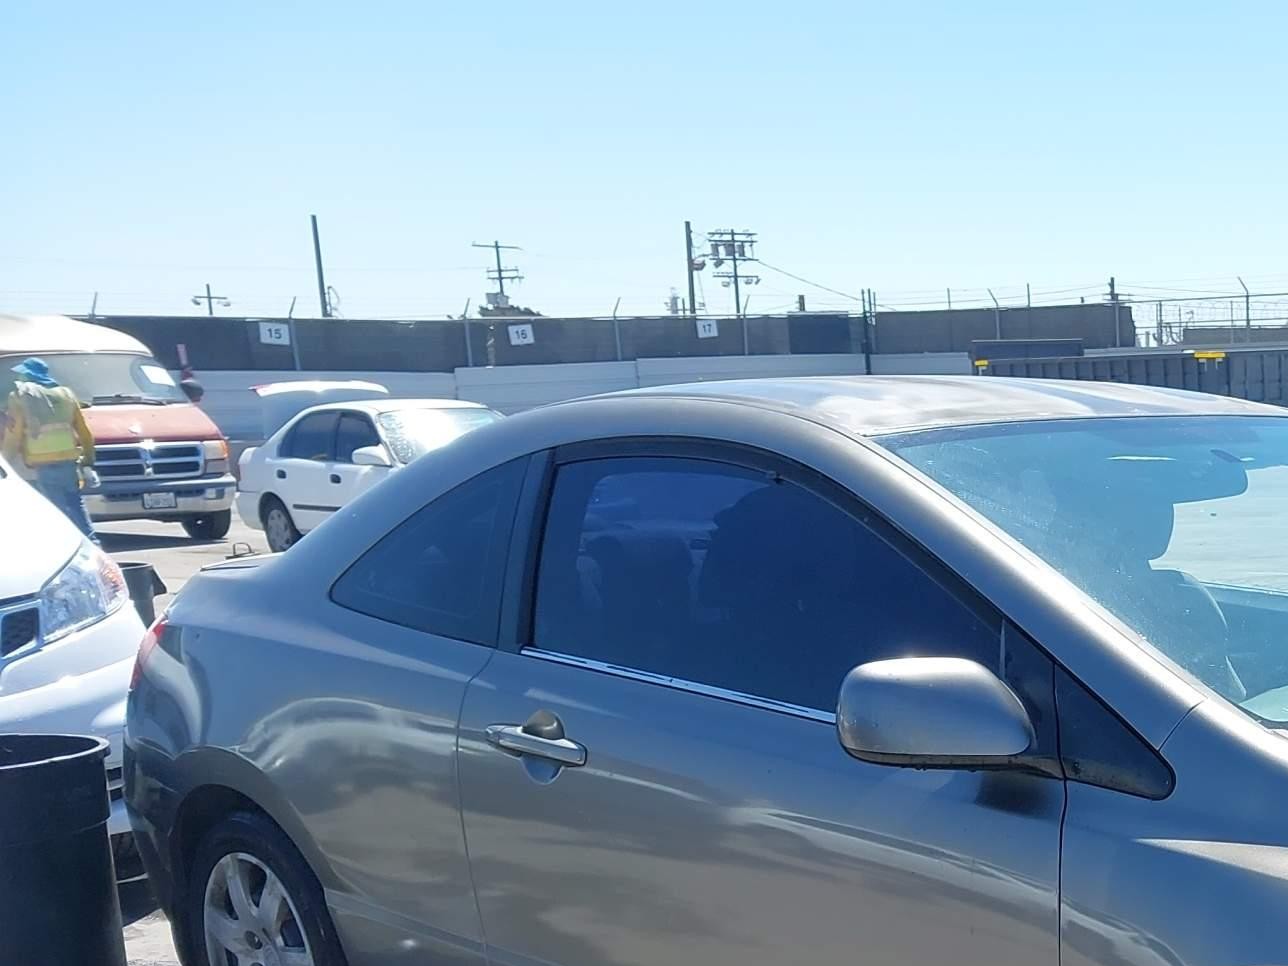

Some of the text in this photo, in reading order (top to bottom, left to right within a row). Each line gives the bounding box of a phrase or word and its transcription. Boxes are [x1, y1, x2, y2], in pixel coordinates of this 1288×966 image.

[266, 327, 282, 340] 15
[515, 328, 528, 340] 16
[702, 323, 712, 334] 17
